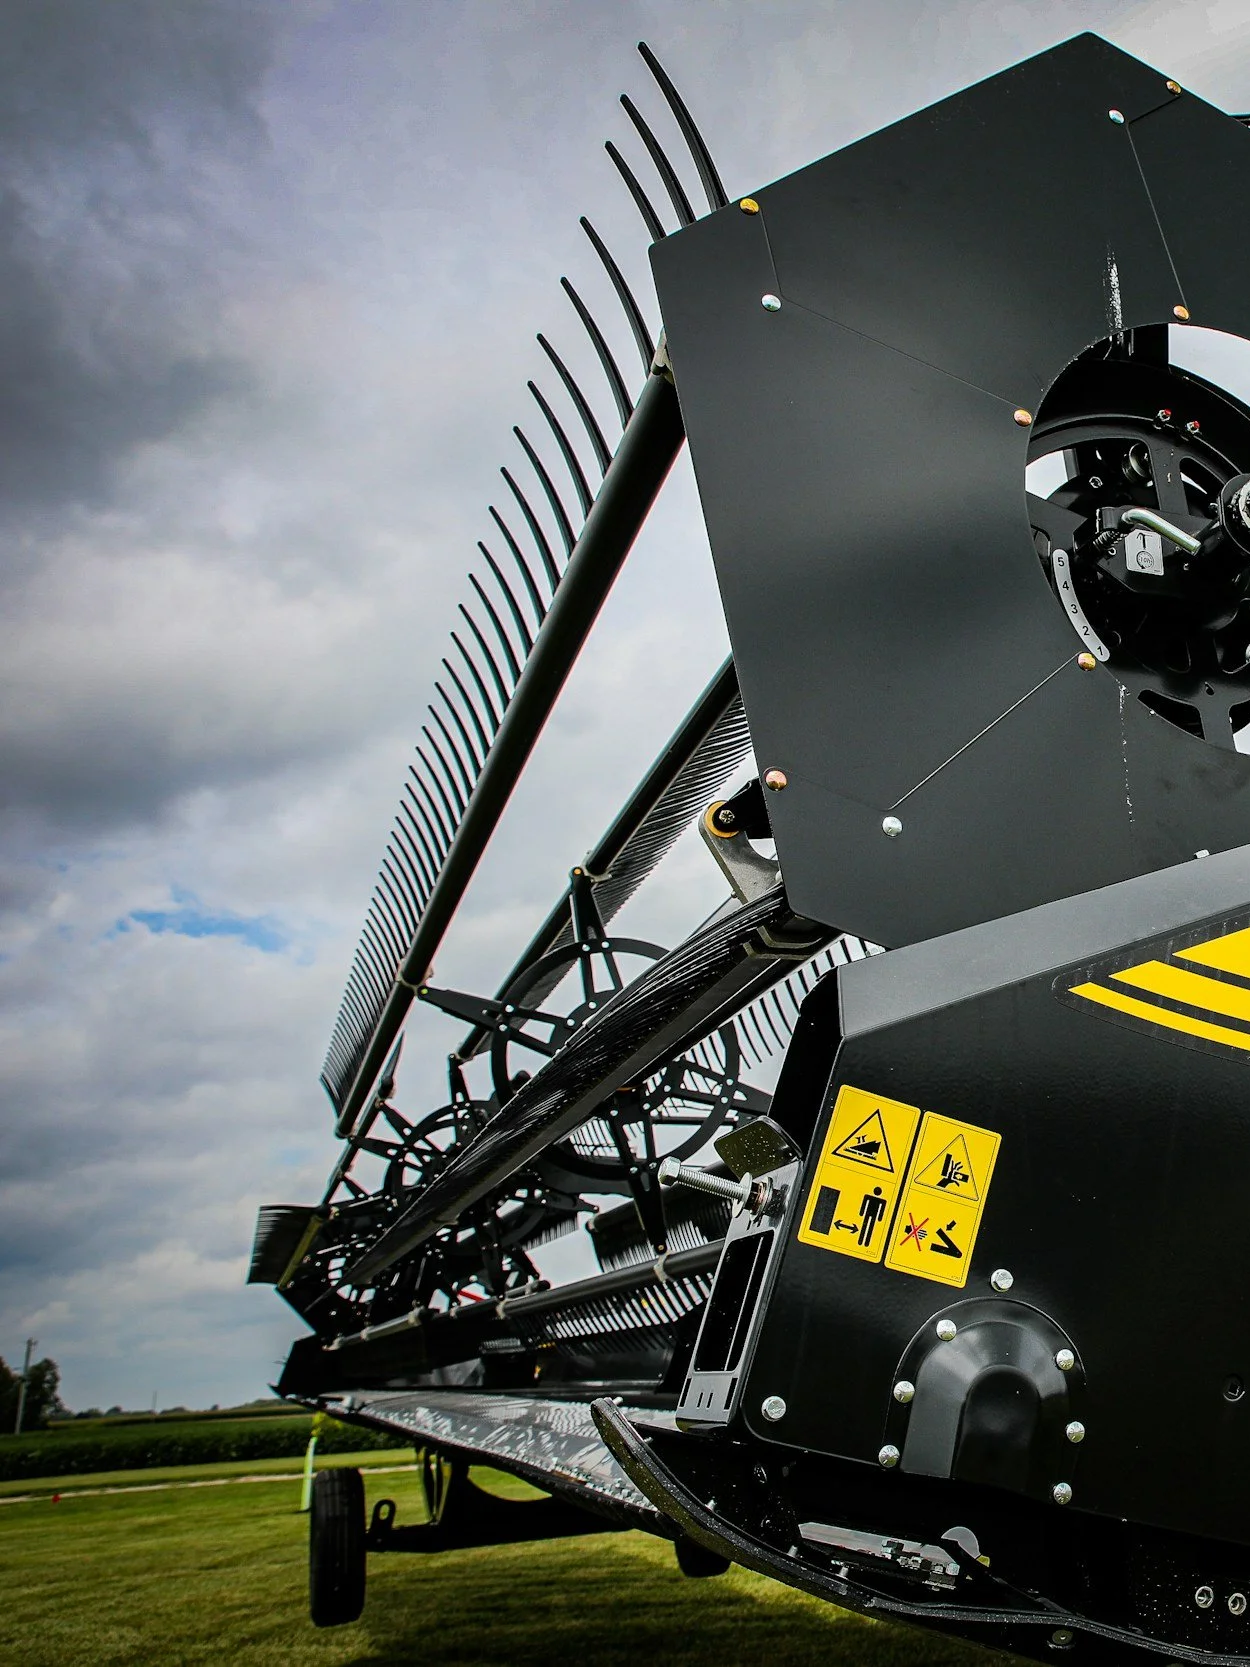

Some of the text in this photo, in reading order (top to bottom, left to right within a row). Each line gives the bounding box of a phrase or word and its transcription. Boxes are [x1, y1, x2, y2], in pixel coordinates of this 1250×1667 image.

[1057, 557, 1065, 566] 5
[1062, 581, 1069, 590] 4
[1071, 604, 1078, 613] 3
[1082, 626, 1090, 635] 2
[1097, 646, 1103, 655] 1
